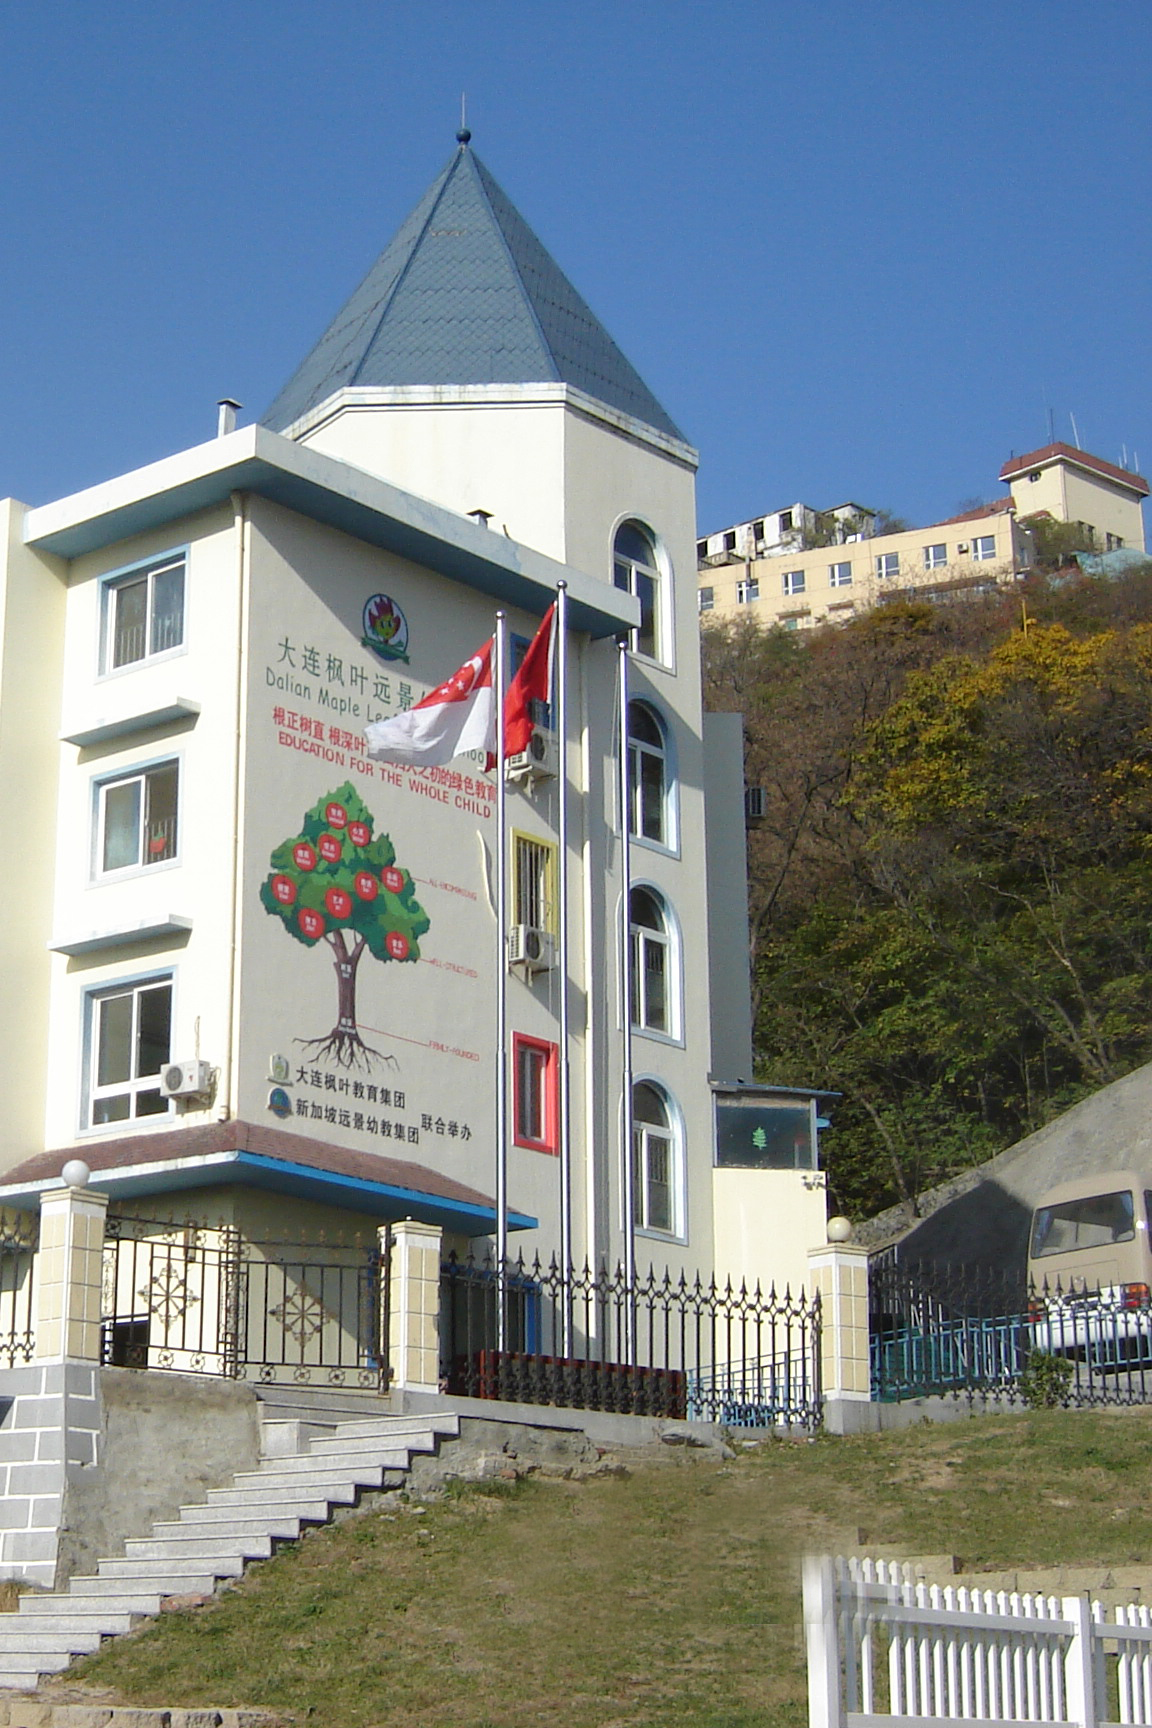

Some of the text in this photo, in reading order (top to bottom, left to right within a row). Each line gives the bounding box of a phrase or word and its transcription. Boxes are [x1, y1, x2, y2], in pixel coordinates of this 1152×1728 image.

[266, 666, 311, 701] Dalian
[318, 686, 360, 717] Maple
[276, 636, 425, 712] 大连枫叶远景
[273, 705, 325, 742] 根正树直
[279, 731, 491, 819] EDUCATION FOR THE WHOLE CHILD
[296, 1065, 406, 1109] 大连枫叶教育集团
[296, 1098, 419, 1145] 新加坡远景幼教集团
[421, 1113, 473, 1141] 联合举办
